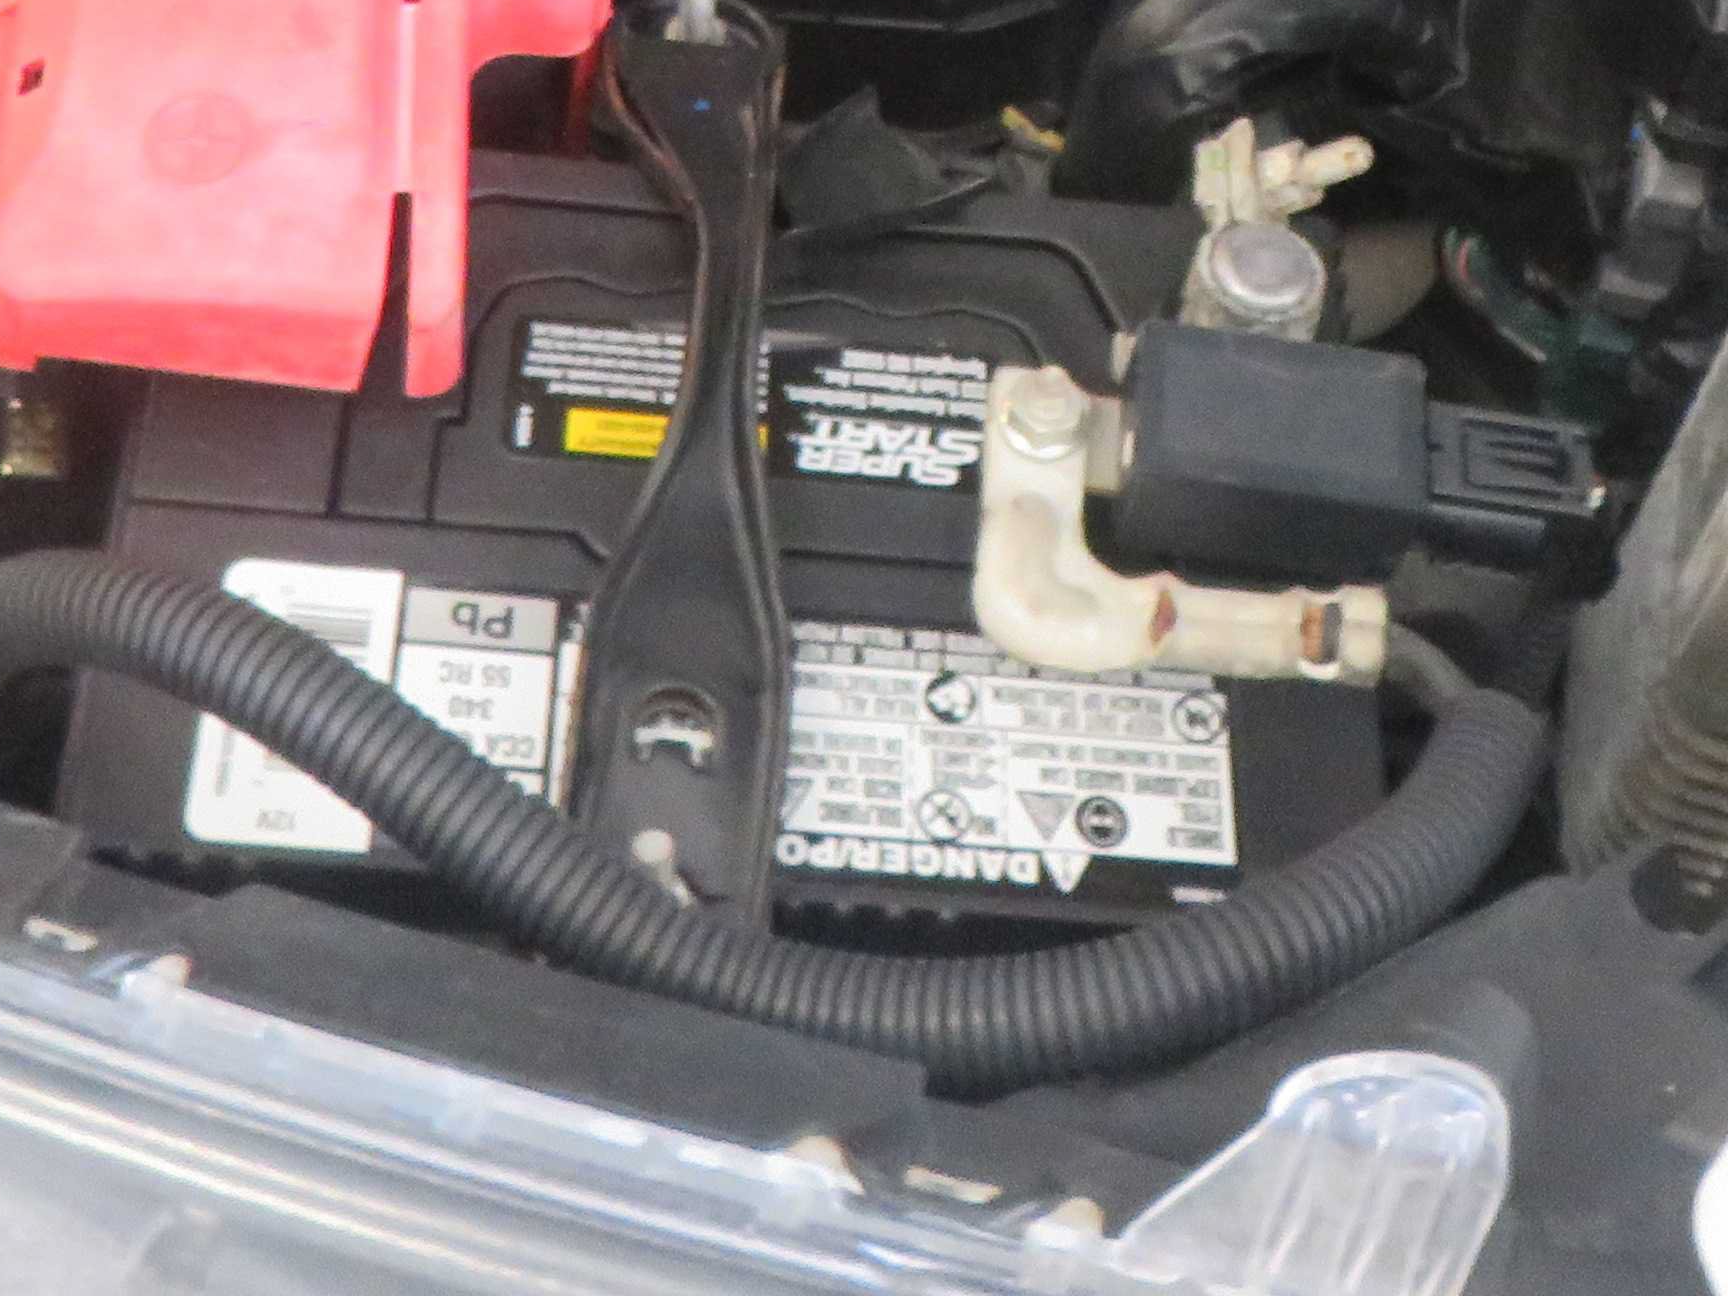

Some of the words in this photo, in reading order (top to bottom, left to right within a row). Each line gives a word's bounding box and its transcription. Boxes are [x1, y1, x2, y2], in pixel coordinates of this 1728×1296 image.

[794, 413, 983, 466] START
[795, 445, 962, 488] SUPER
[450, 601, 515, 639] Pb
[776, 835, 1040, 885] DANGER/PO
